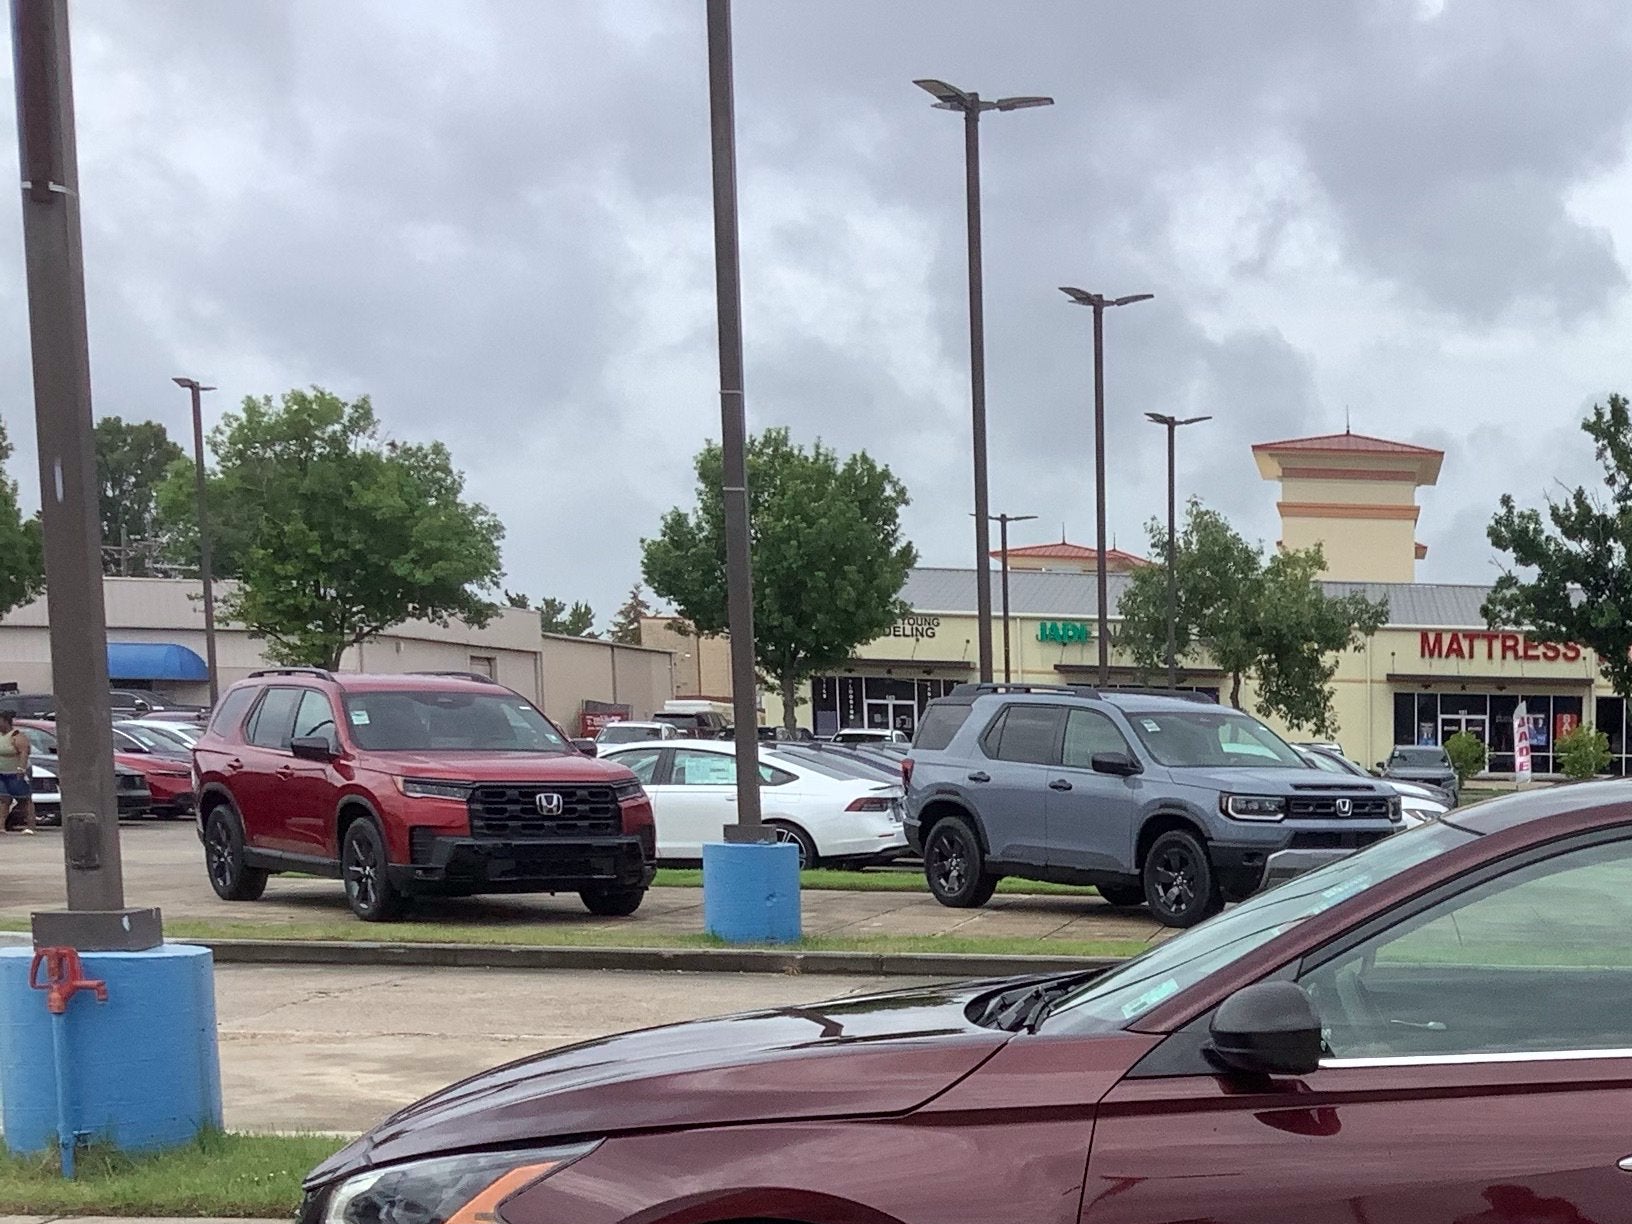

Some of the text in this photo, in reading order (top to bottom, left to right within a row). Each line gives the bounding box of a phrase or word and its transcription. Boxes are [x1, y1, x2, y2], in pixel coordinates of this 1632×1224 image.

[883, 626, 936, 638] DELING
[901, 617, 940, 627] YOUNG
[1420, 631, 1581, 662] MATTRESS
[1517, 715, 1531, 772] JADE
